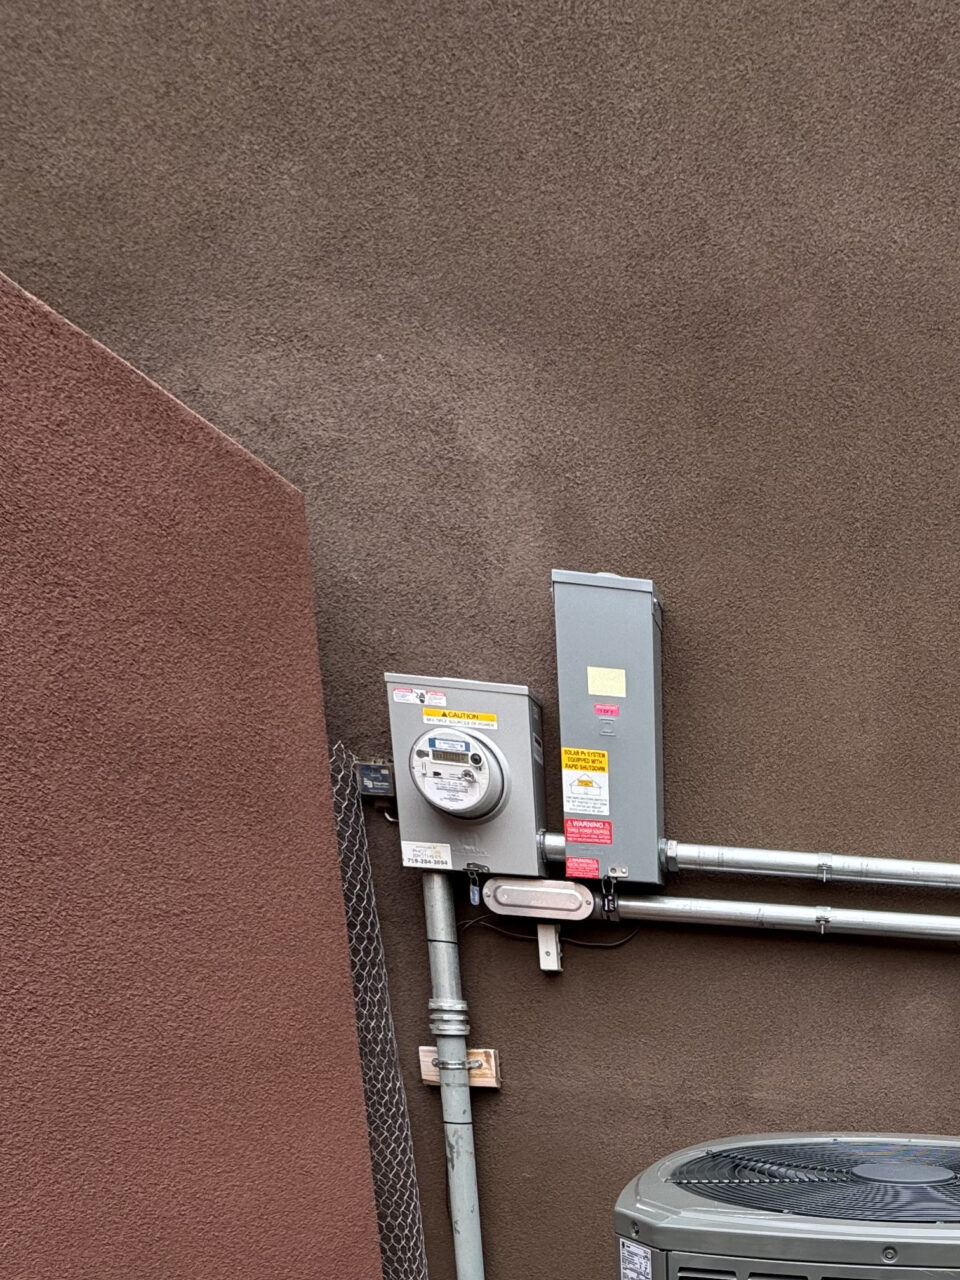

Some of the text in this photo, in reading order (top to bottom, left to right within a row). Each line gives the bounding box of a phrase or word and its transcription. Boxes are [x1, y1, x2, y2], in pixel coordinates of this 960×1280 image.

[447, 711, 479, 720] CAUTION
[567, 756, 590, 764] EQUIPPED
[580, 764, 605, 772] SHUTDOWN
[572, 820, 604, 828] WARNING
